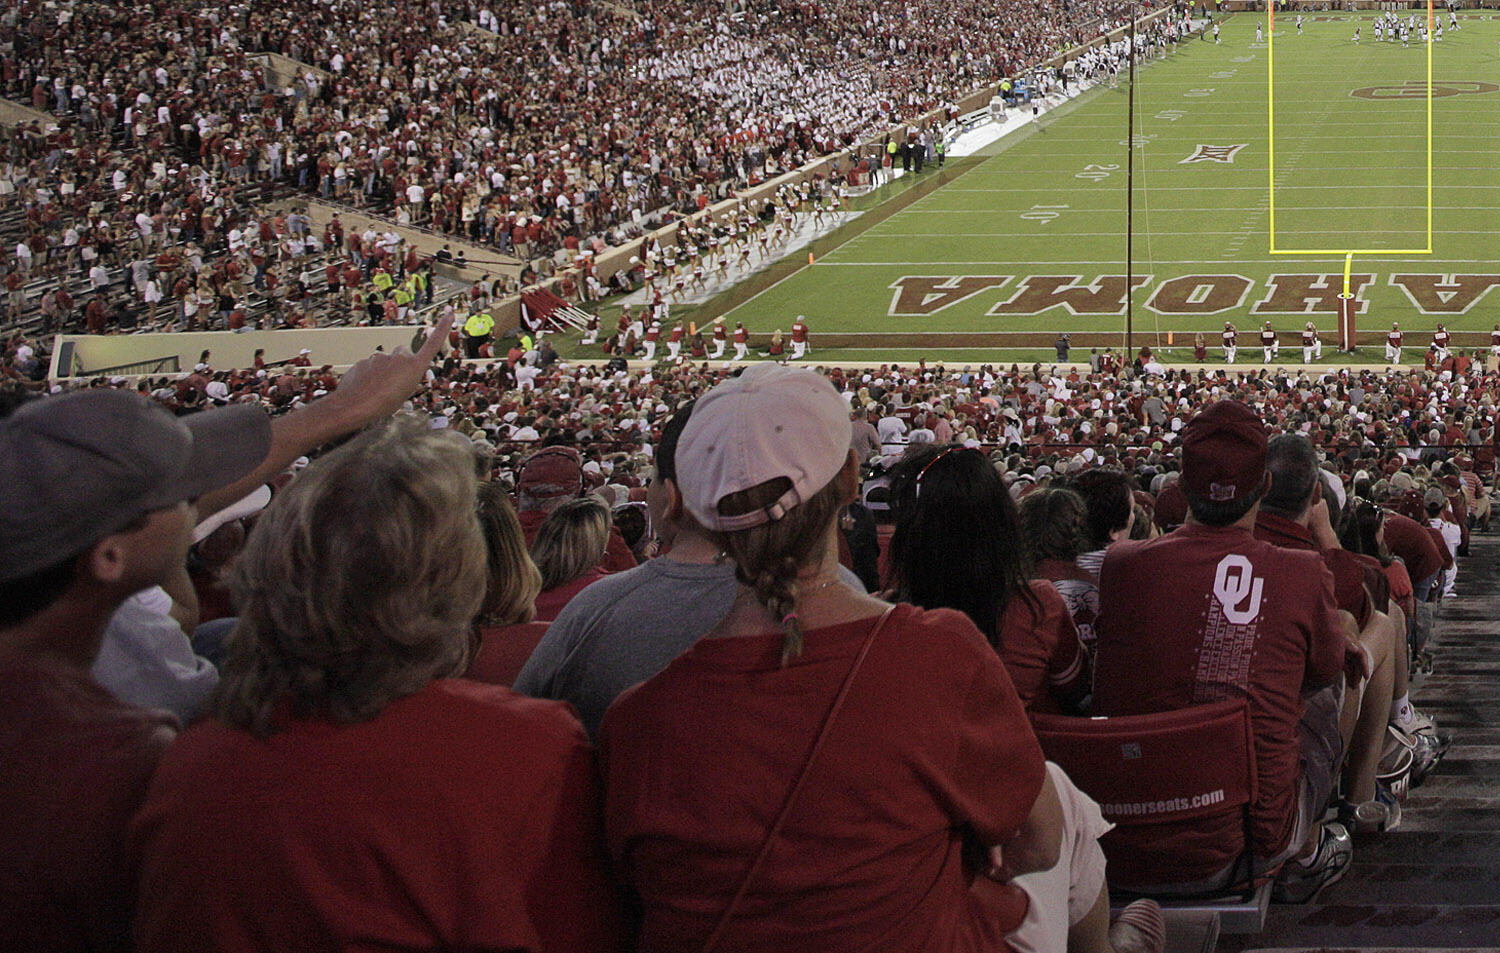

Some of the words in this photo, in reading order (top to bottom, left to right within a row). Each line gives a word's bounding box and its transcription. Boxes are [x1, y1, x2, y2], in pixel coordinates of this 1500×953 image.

[1074, 162, 1121, 179] 20
[1019, 204, 1071, 221] 10
[1213, 553, 1265, 625] OU
[1244, 624, 1257, 650] PRIDE
